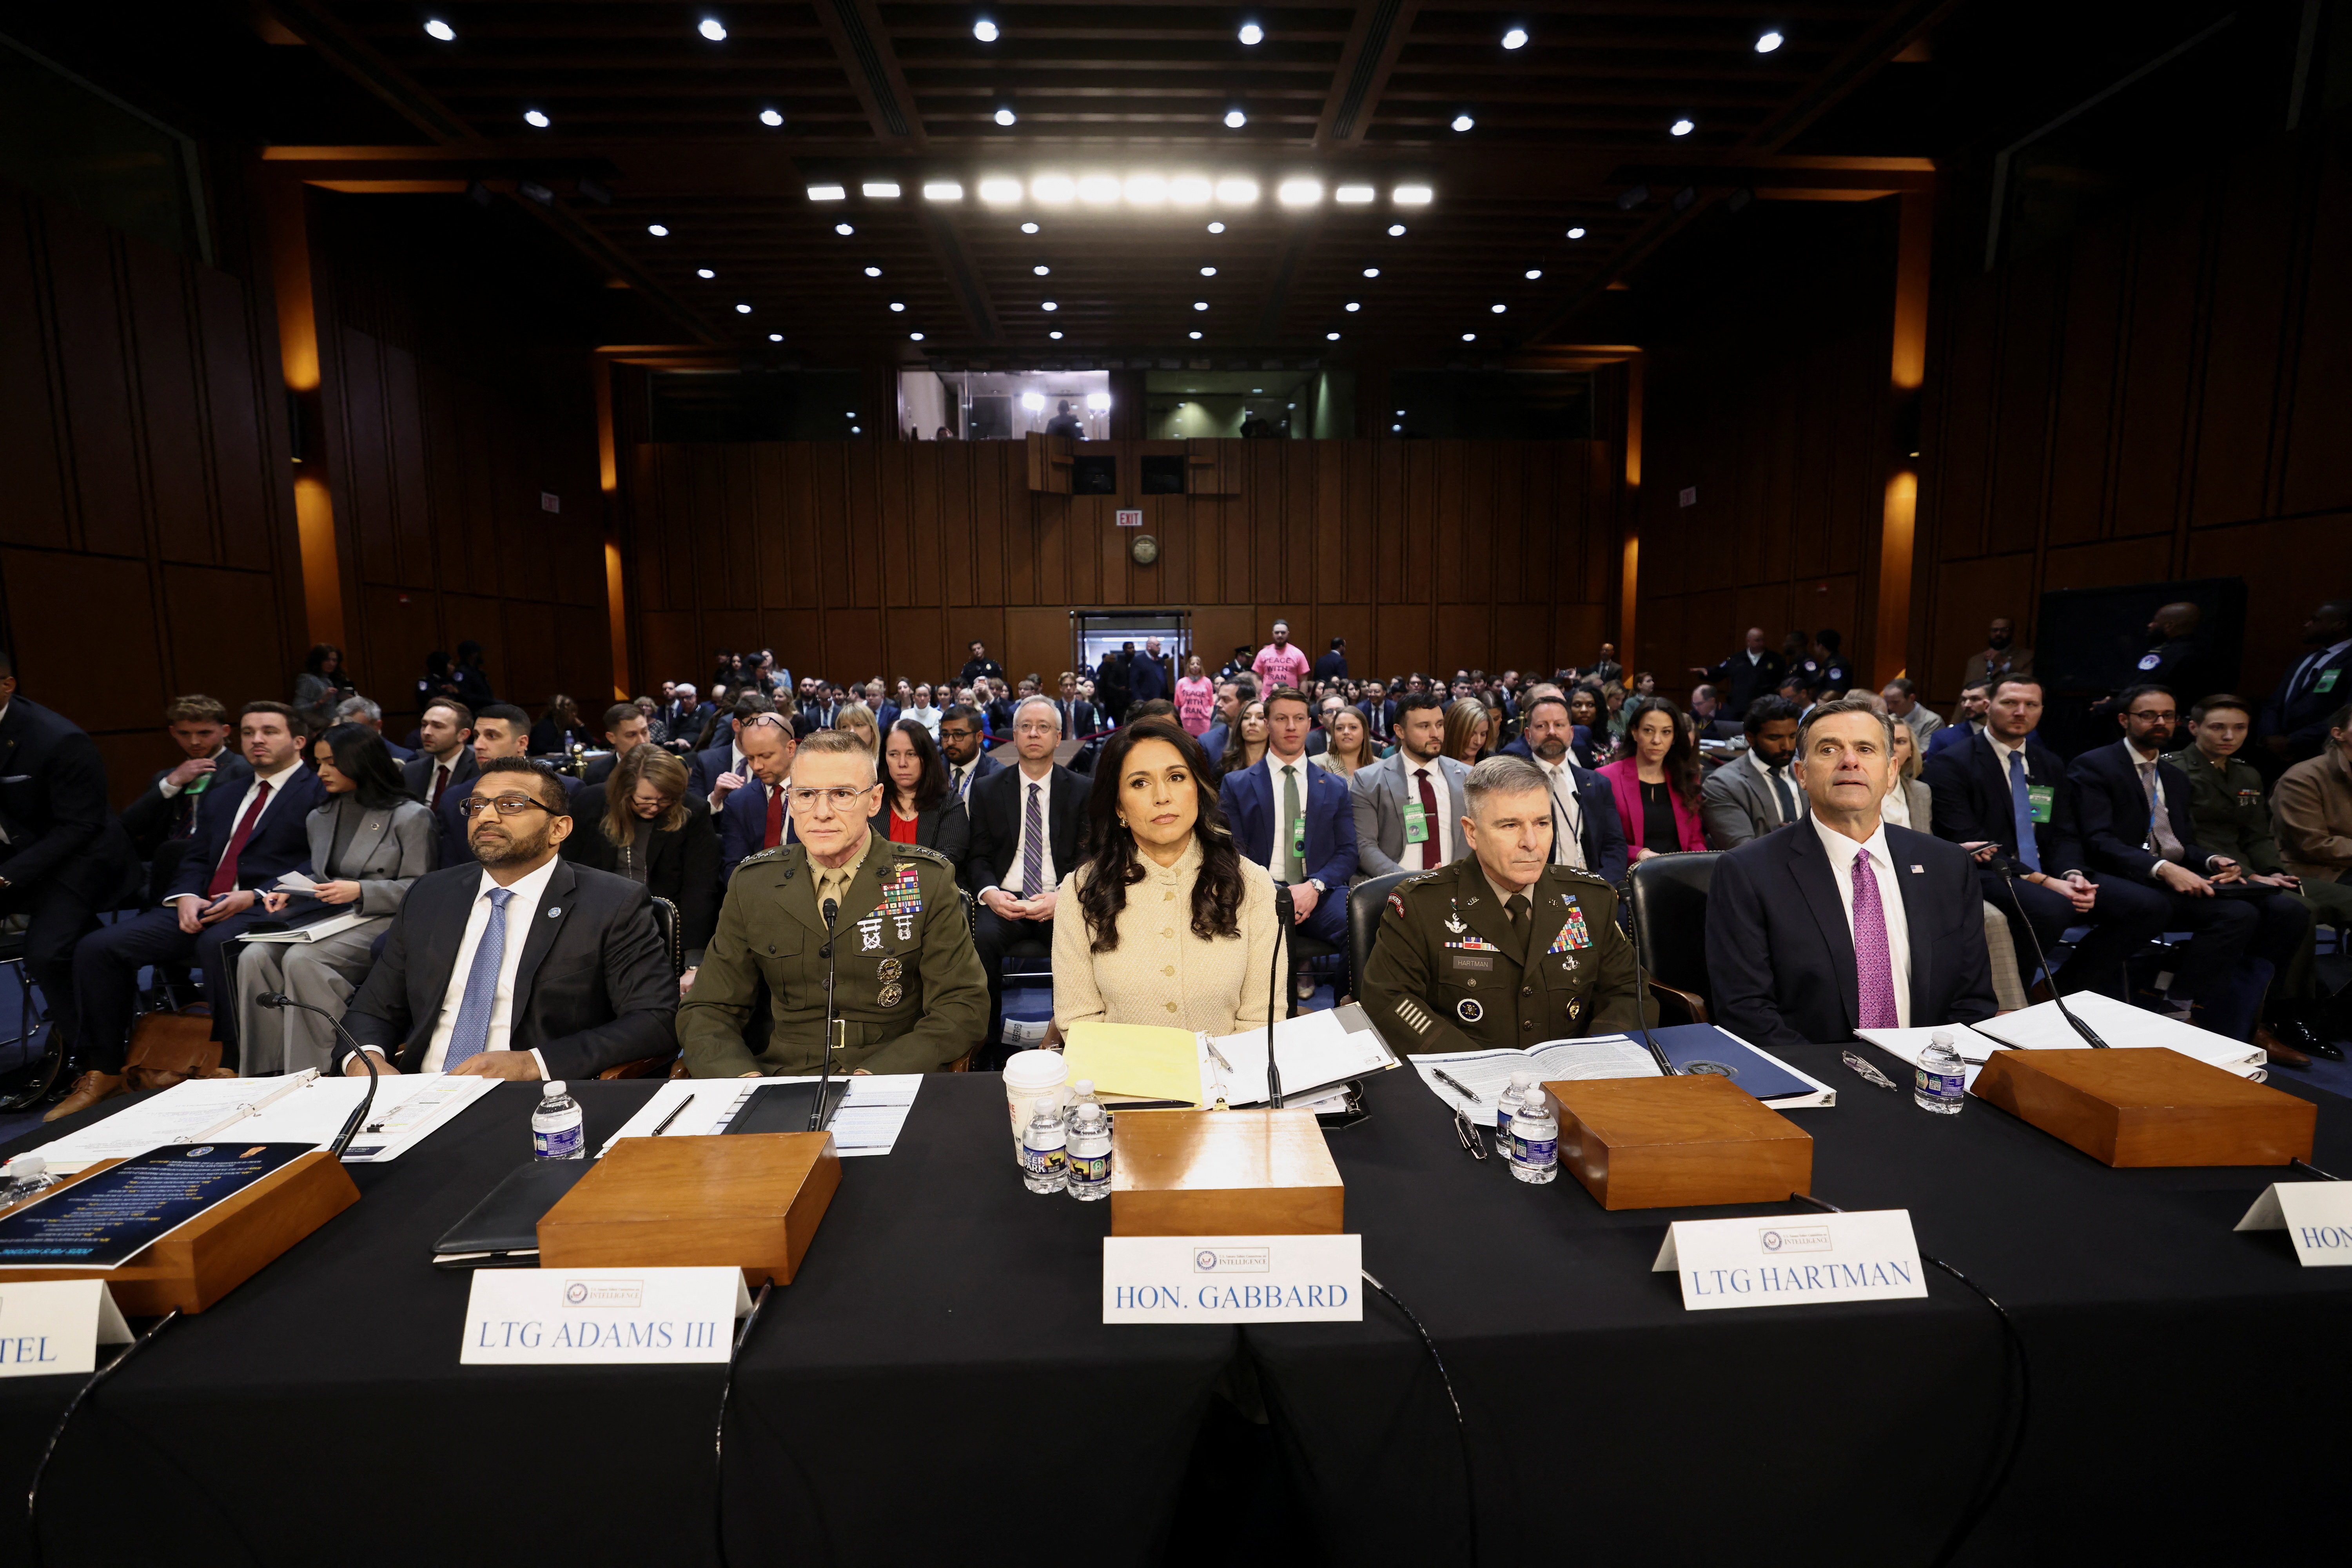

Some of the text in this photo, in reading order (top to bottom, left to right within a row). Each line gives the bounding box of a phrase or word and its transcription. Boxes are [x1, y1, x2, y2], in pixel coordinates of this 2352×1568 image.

[1120, 512, 1139, 524] EXIT
[1011, 1023, 1022, 1043] RESERVED
[1024, 1151, 1045, 1165] DEER
[1024, 1160, 1046, 1173] PARK
[1690, 1261, 1913, 1295] LTG HARTMAN
[1115, 1285, 1348, 1309] HON. GABBARD
[479, 1321, 717, 1348] LTG ADAMS III
